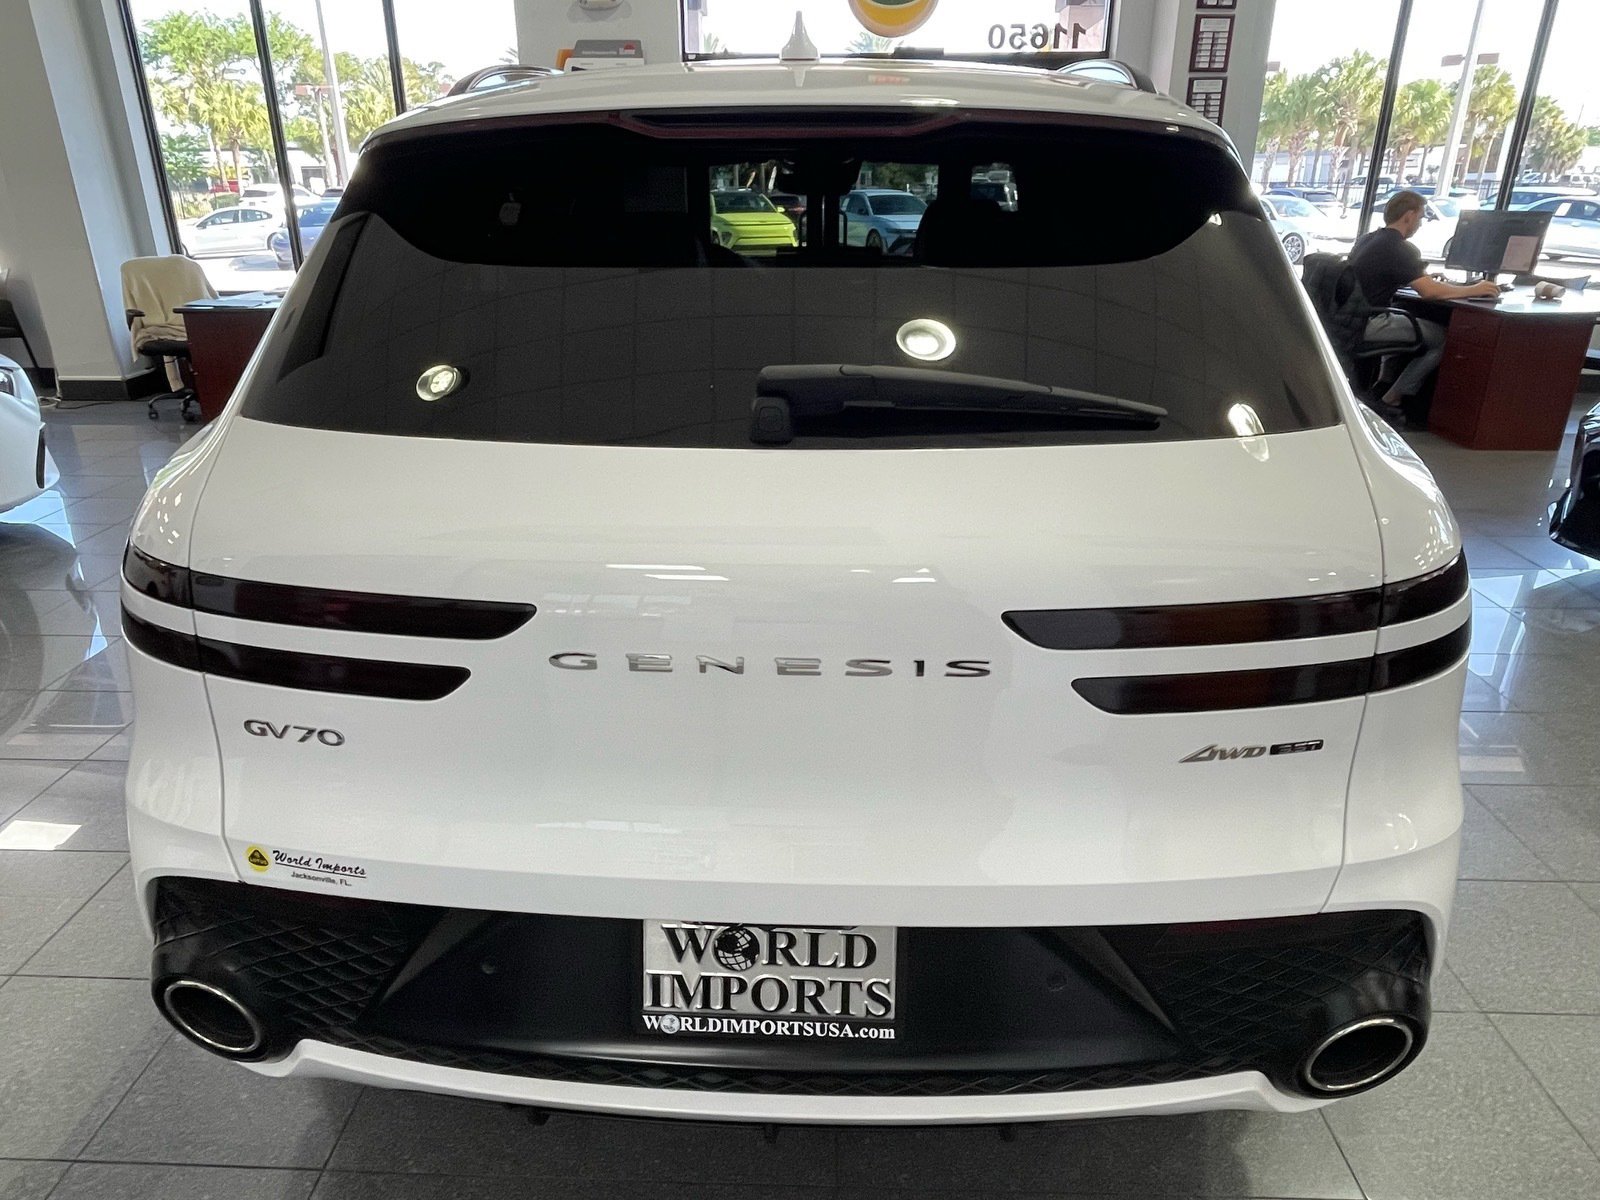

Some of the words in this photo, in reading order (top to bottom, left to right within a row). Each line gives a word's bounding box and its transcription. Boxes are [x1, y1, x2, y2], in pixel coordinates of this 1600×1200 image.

[548, 652, 991, 678] GENESIS
[243, 719, 345, 746] GV70
[1178, 744, 1267, 763] AWD
[272, 849, 312, 868] World
[315, 857, 366, 875] Imports
[661, 923, 877, 972] WORLD
[646, 970, 893, 1019] IMPORTS
[642, 1014, 896, 1040] WORLDIMPORTSUSA.com
